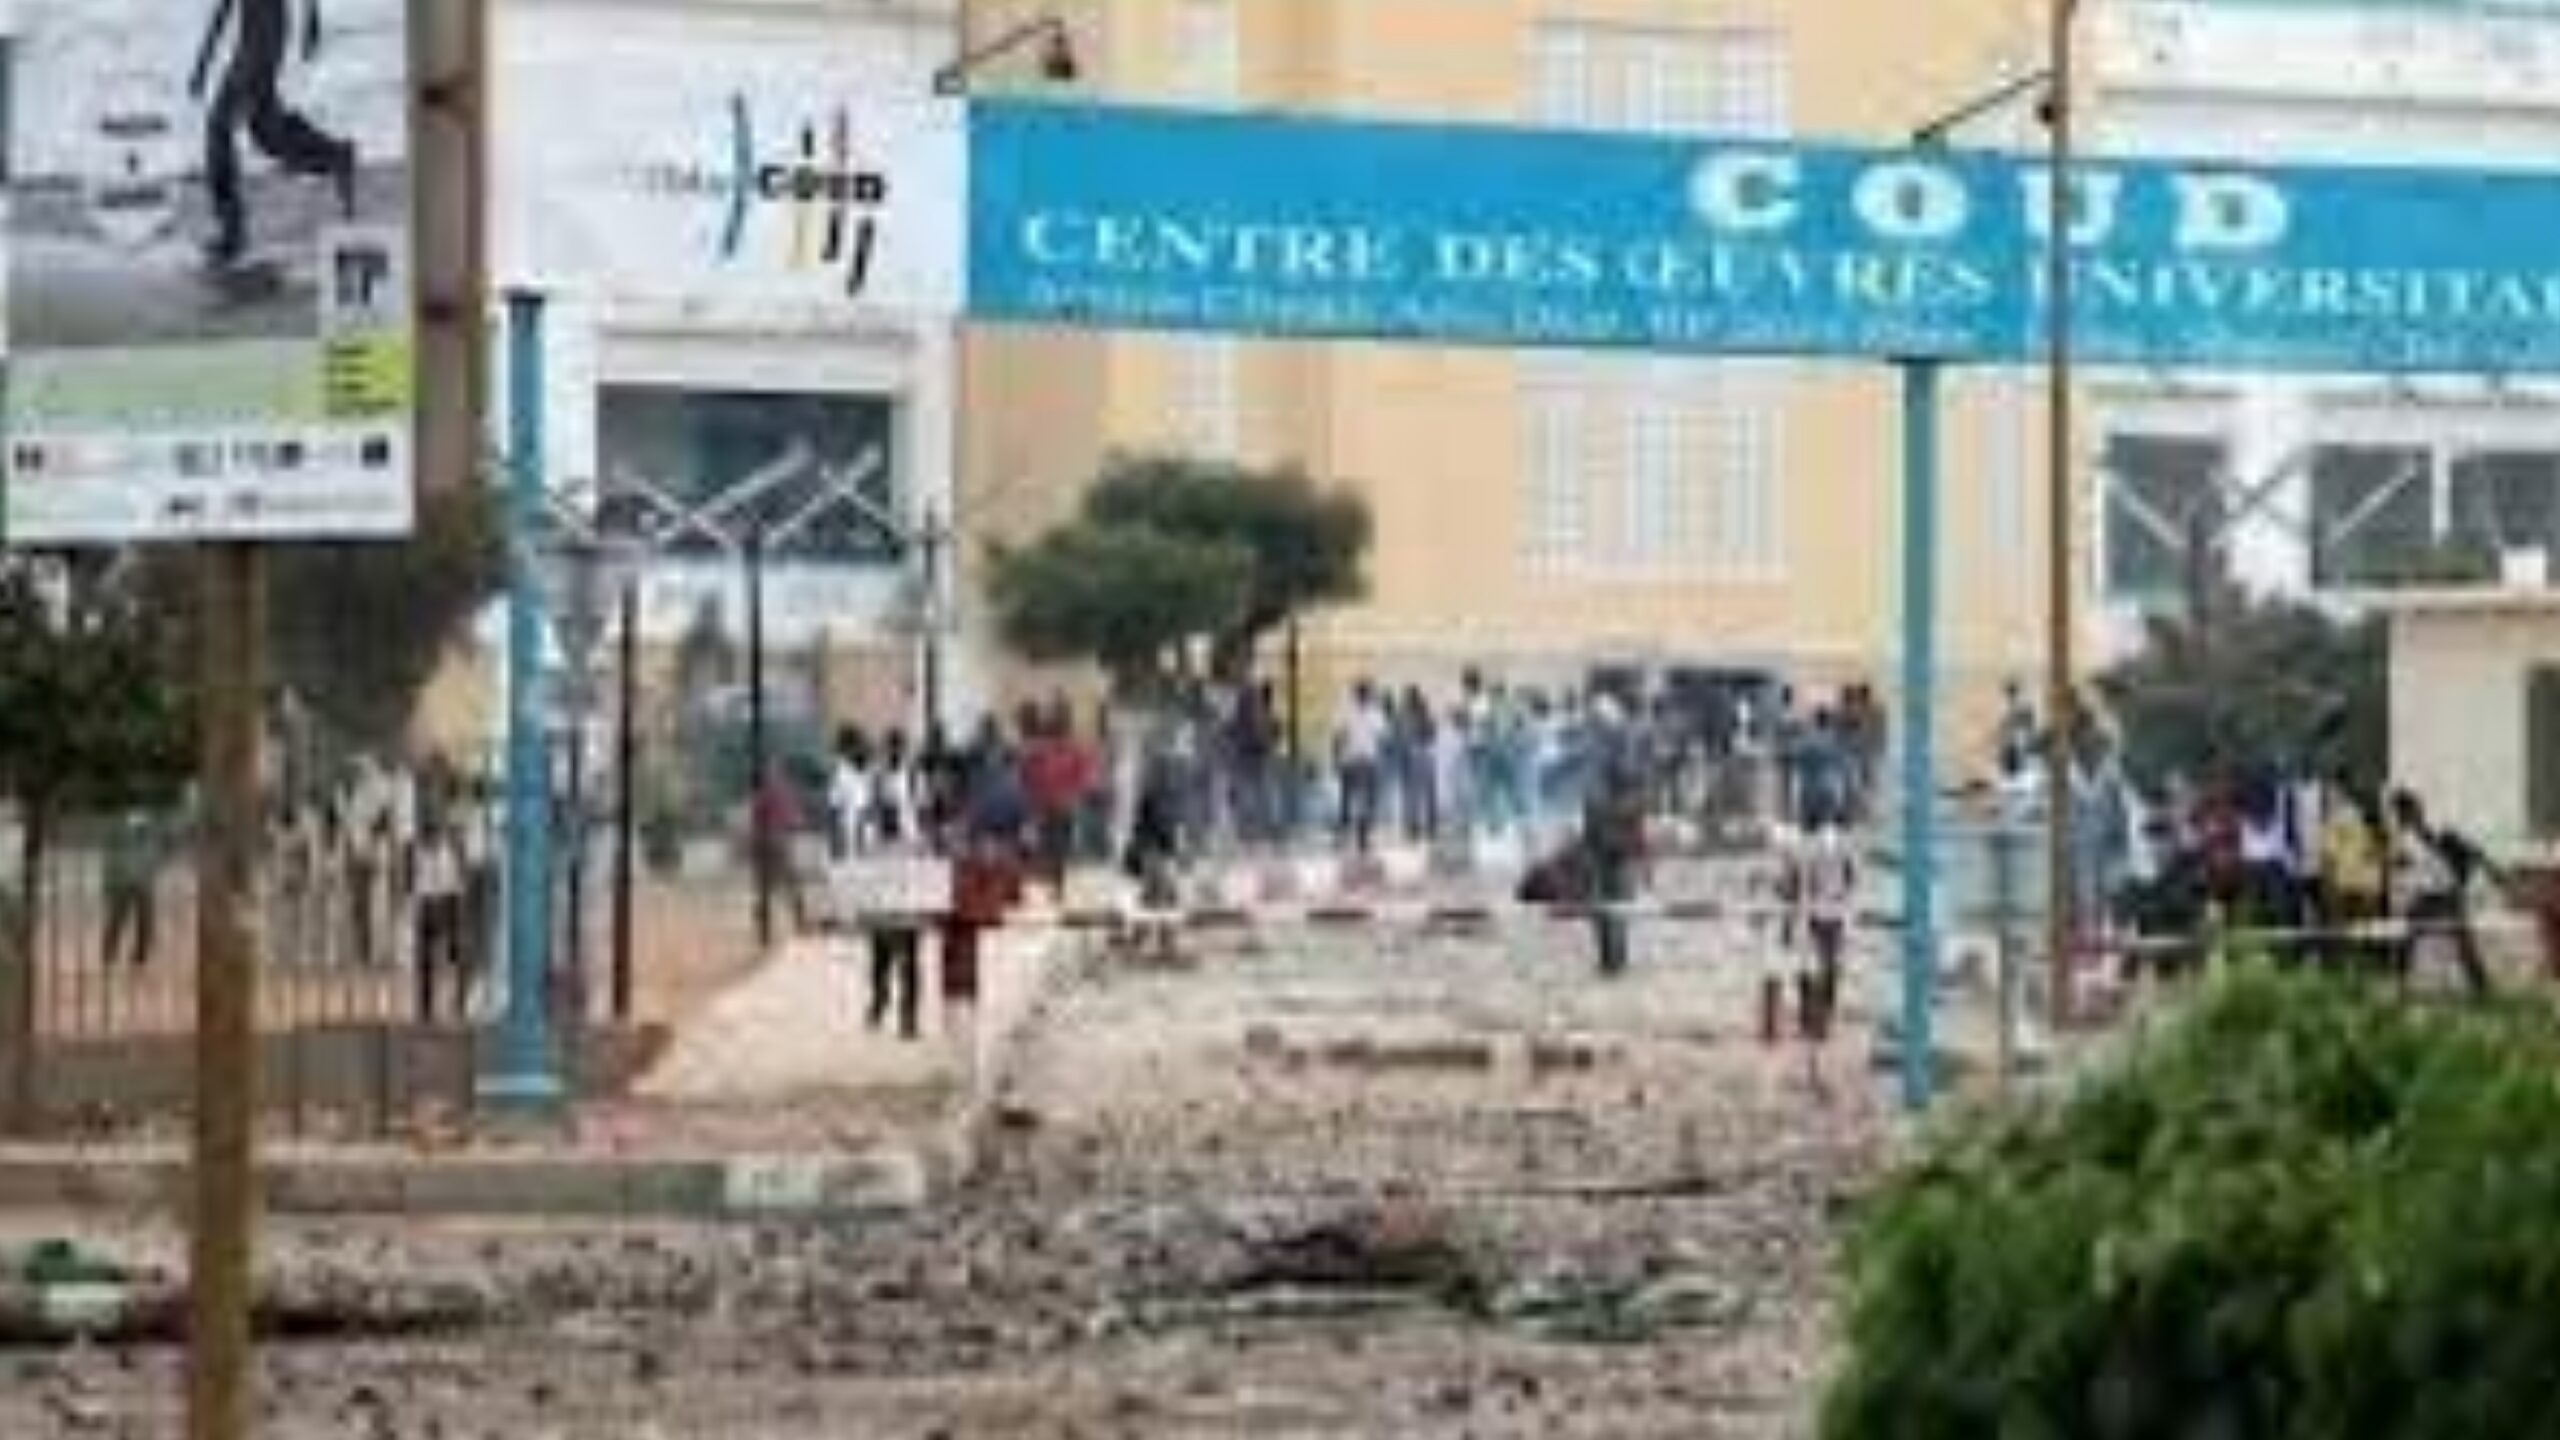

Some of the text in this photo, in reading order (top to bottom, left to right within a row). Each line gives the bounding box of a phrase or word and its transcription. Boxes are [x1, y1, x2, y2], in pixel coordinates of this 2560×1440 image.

[1690, 150, 2288, 253] COUD
[1022, 213, 1396, 281] CENTRE
[1436, 231, 1602, 287] DES
